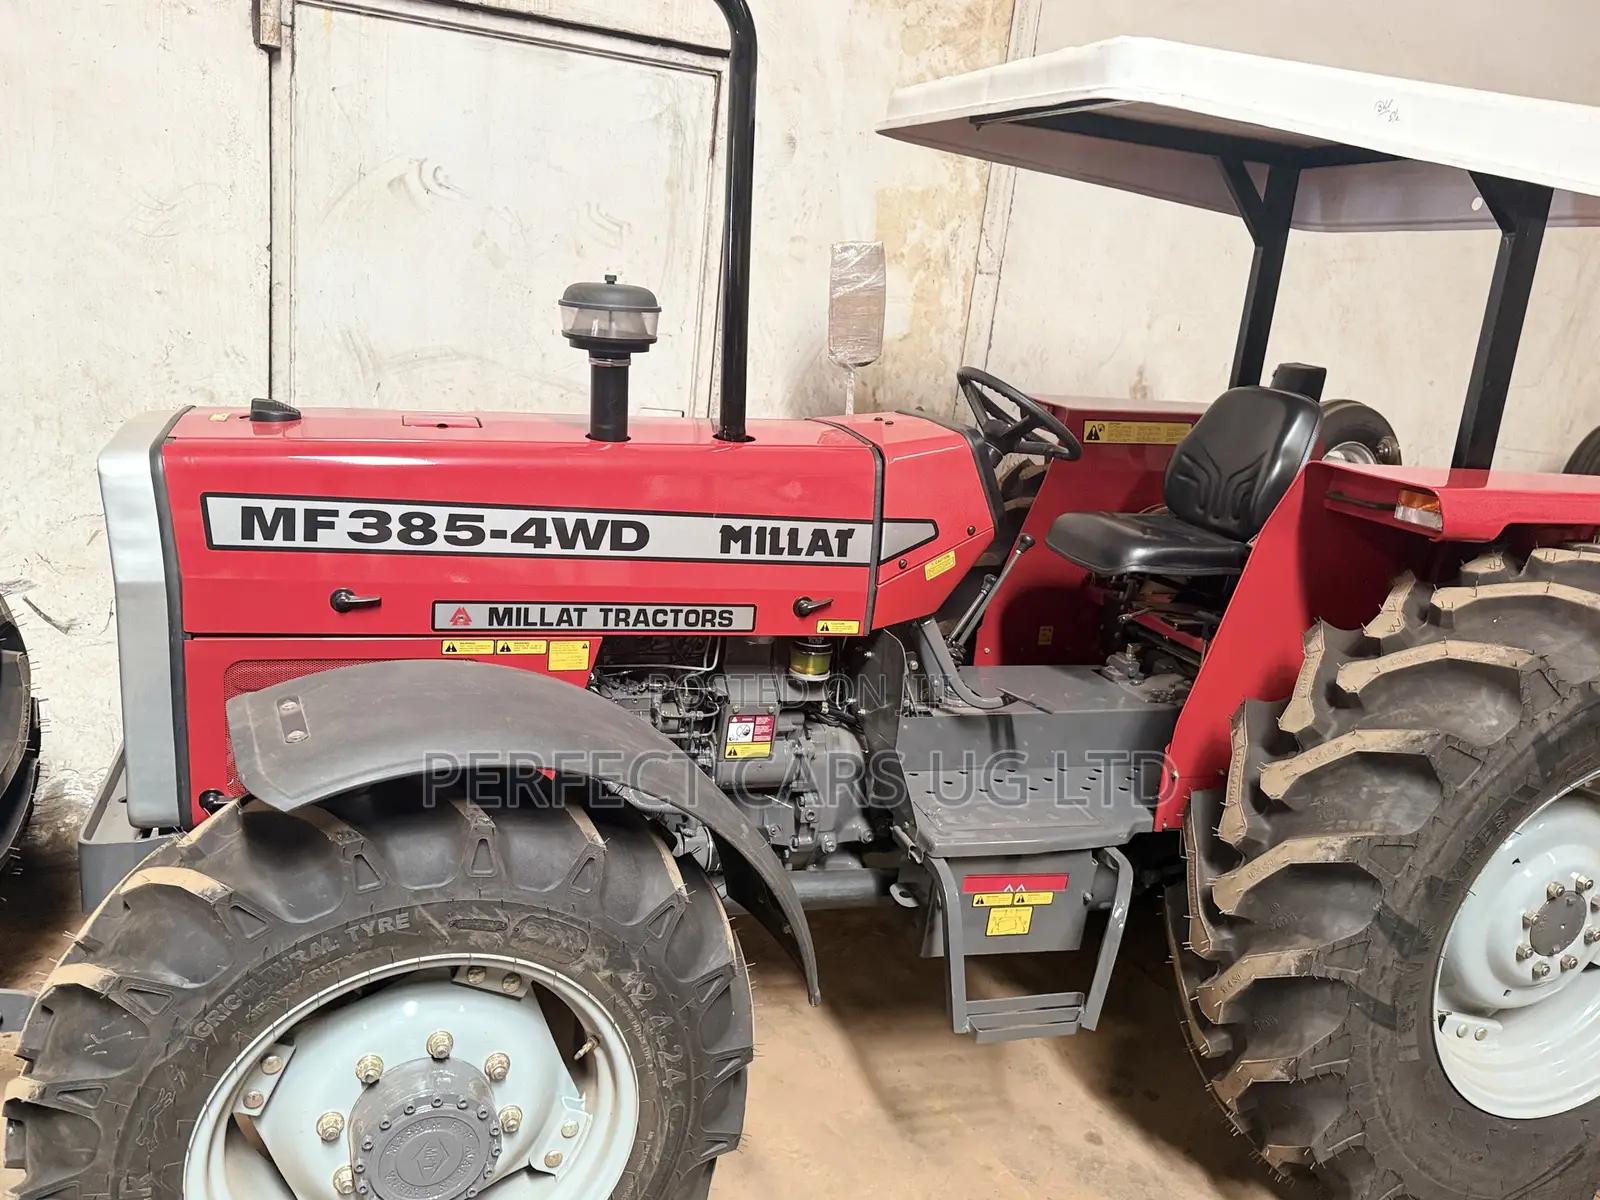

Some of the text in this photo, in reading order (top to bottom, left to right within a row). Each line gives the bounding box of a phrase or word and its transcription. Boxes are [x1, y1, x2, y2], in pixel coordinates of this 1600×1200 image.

[719, 524, 855, 557] MILLAT
[488, 607, 734, 628] MILLAT TRACTORS
[344, 912, 411, 942] TYRE
